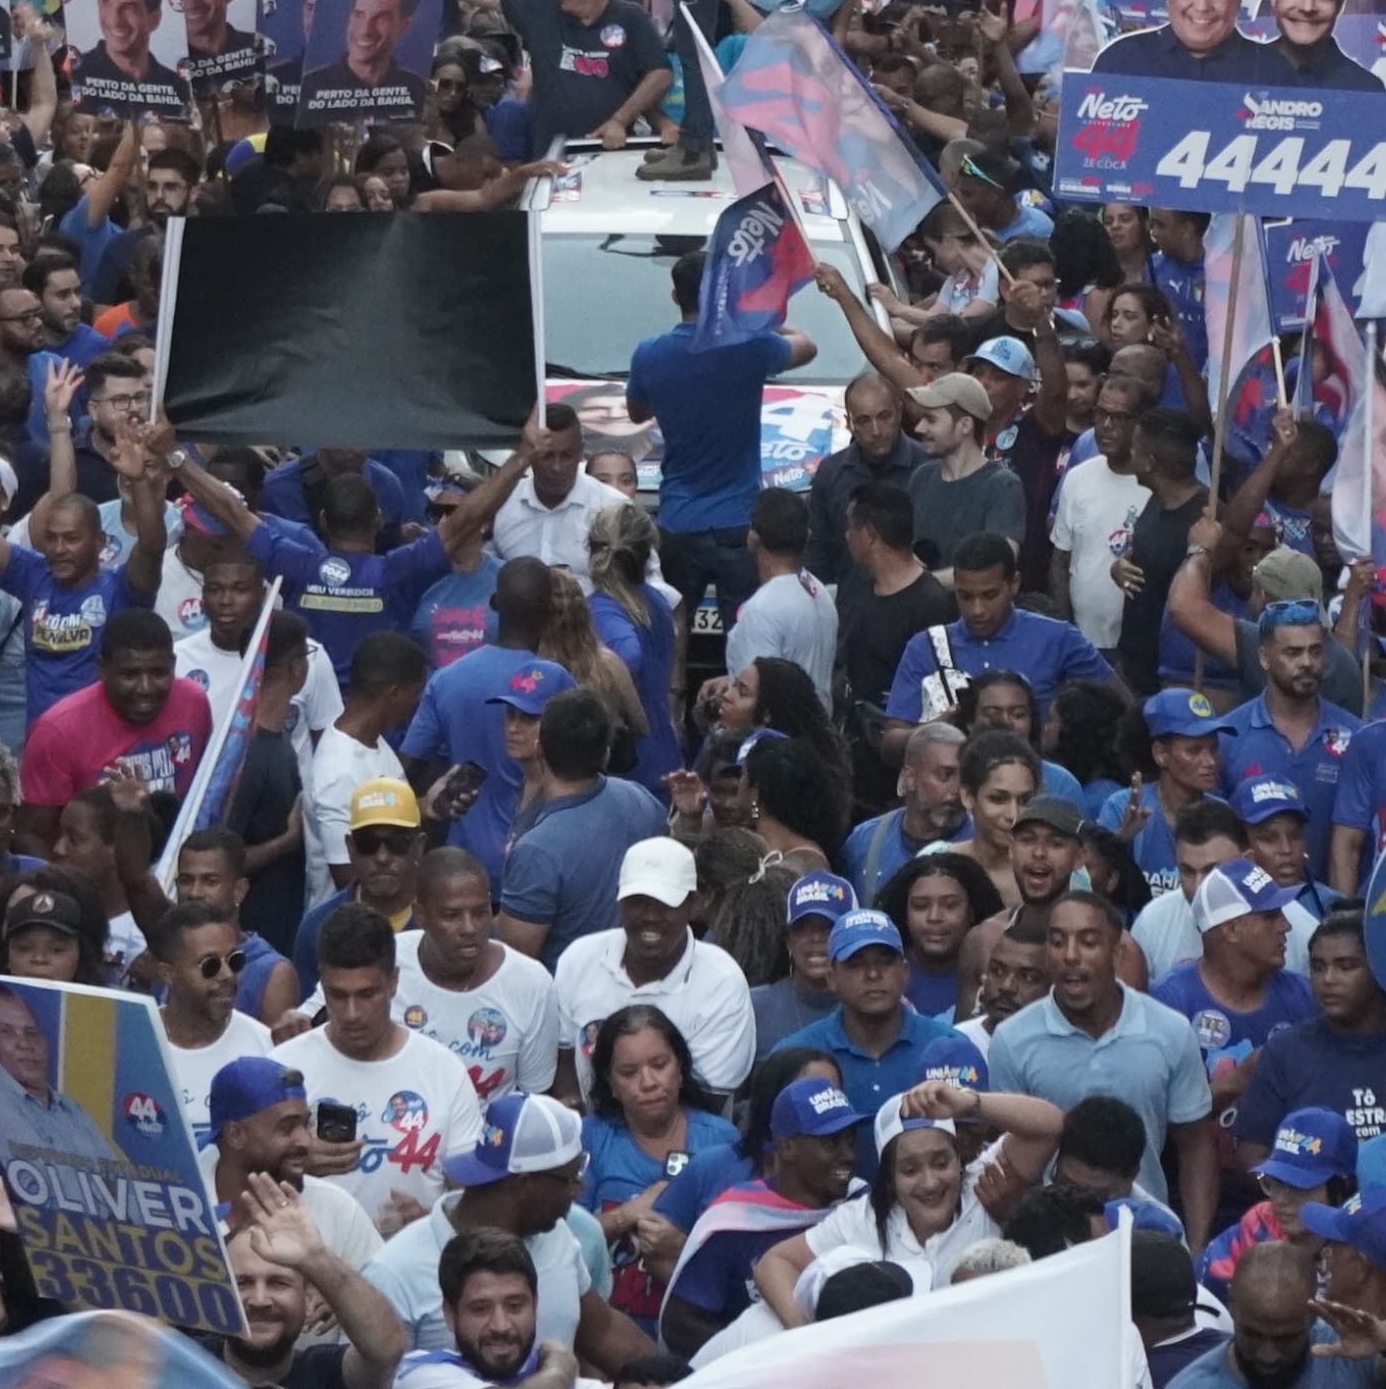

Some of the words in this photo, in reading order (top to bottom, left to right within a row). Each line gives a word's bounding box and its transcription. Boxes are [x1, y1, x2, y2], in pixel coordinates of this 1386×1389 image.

[1076, 92, 1149, 122] Neto
[1245, 115, 1295, 131] REGIS
[1071, 120, 1141, 162] 44
[399, 1111, 425, 1130] 44
[387, 1127, 442, 1174] 44
[7, 1158, 211, 1237] OLIVER
[15, 1205, 227, 1281] SANTOS
[31, 1249, 246, 1335] 33600
